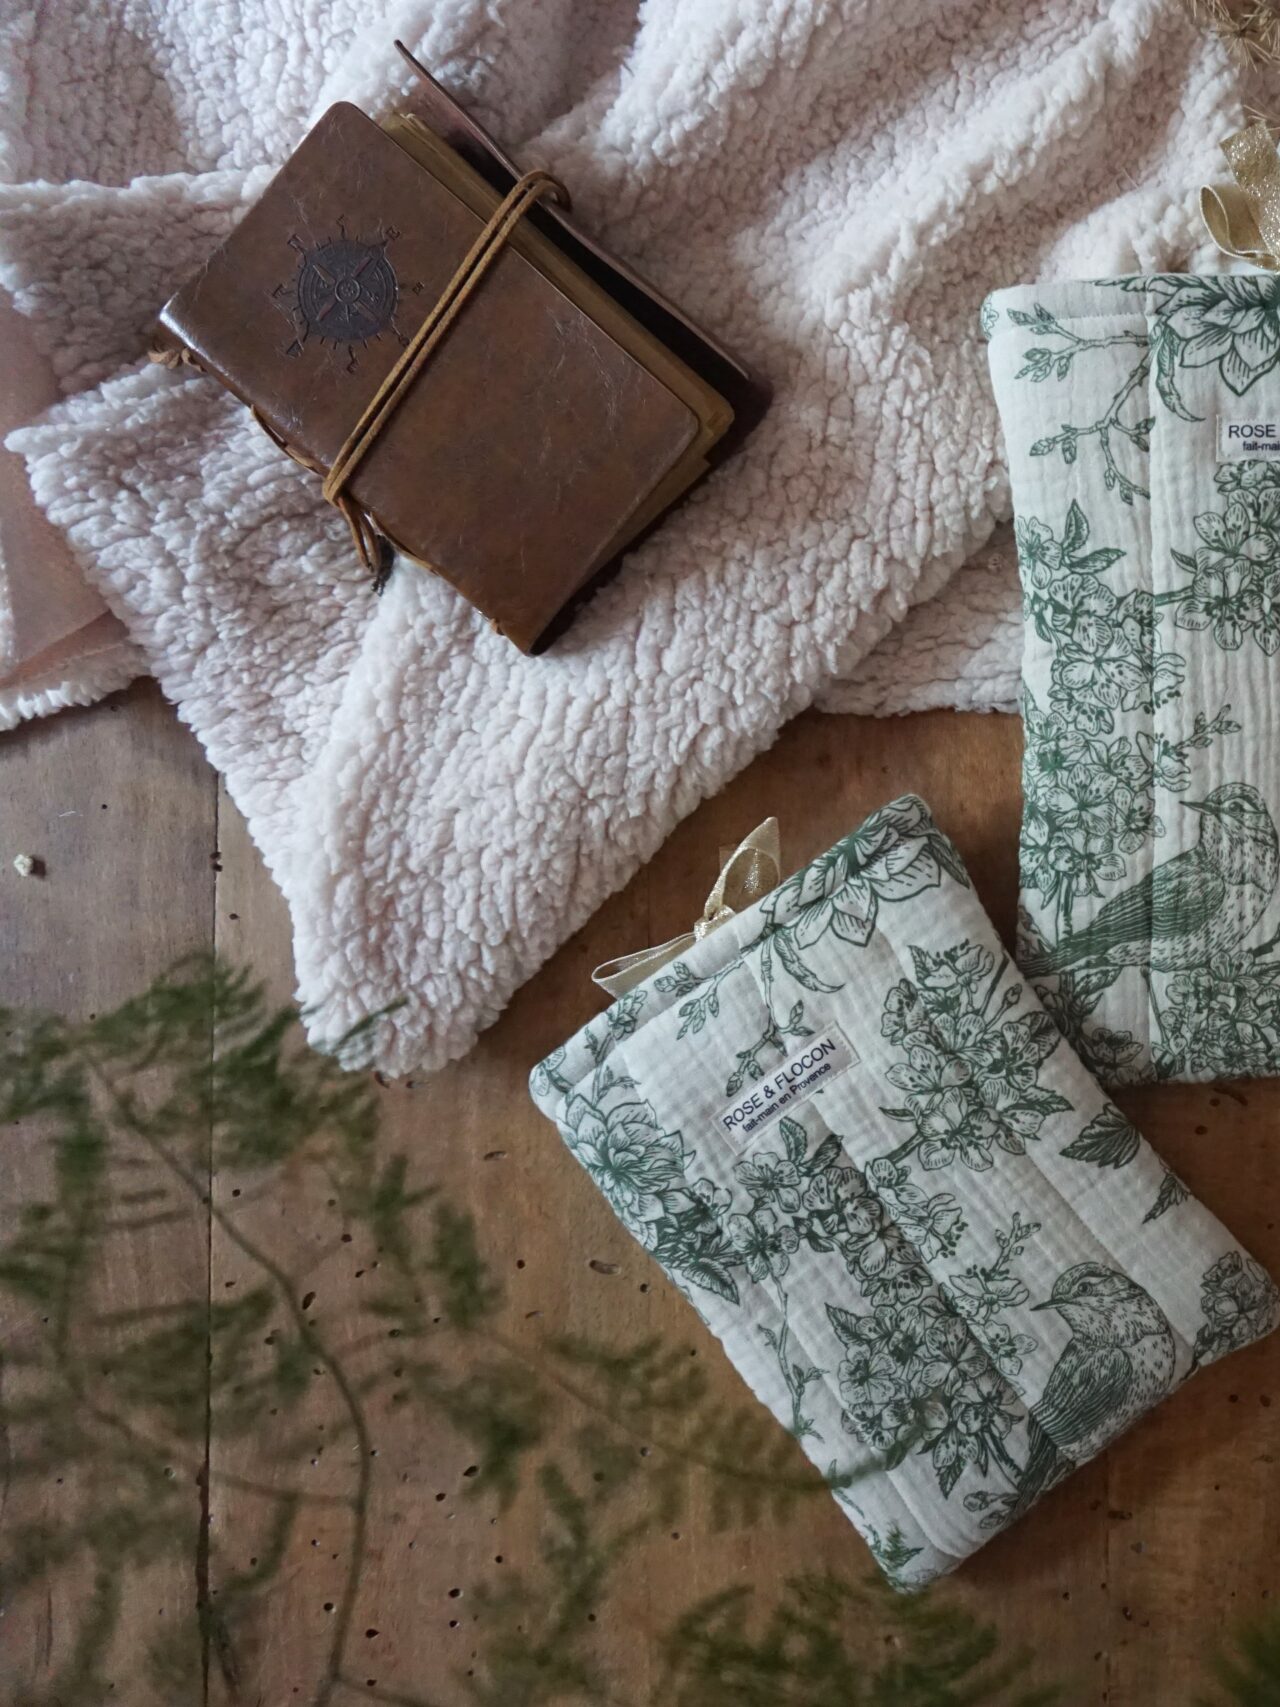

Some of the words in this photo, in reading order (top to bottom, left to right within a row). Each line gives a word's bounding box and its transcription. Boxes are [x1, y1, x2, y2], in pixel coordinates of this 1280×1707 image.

[1228, 424, 1275, 438] ROSE
[722, 1093, 764, 1131] ROSE
[763, 1085, 776, 1099] &
[774, 1038, 837, 1090] FLOCON
[742, 1101, 780, 1133] fait-main
[778, 1093, 792, 1105] en
[789, 1062, 832, 1096] Provence
